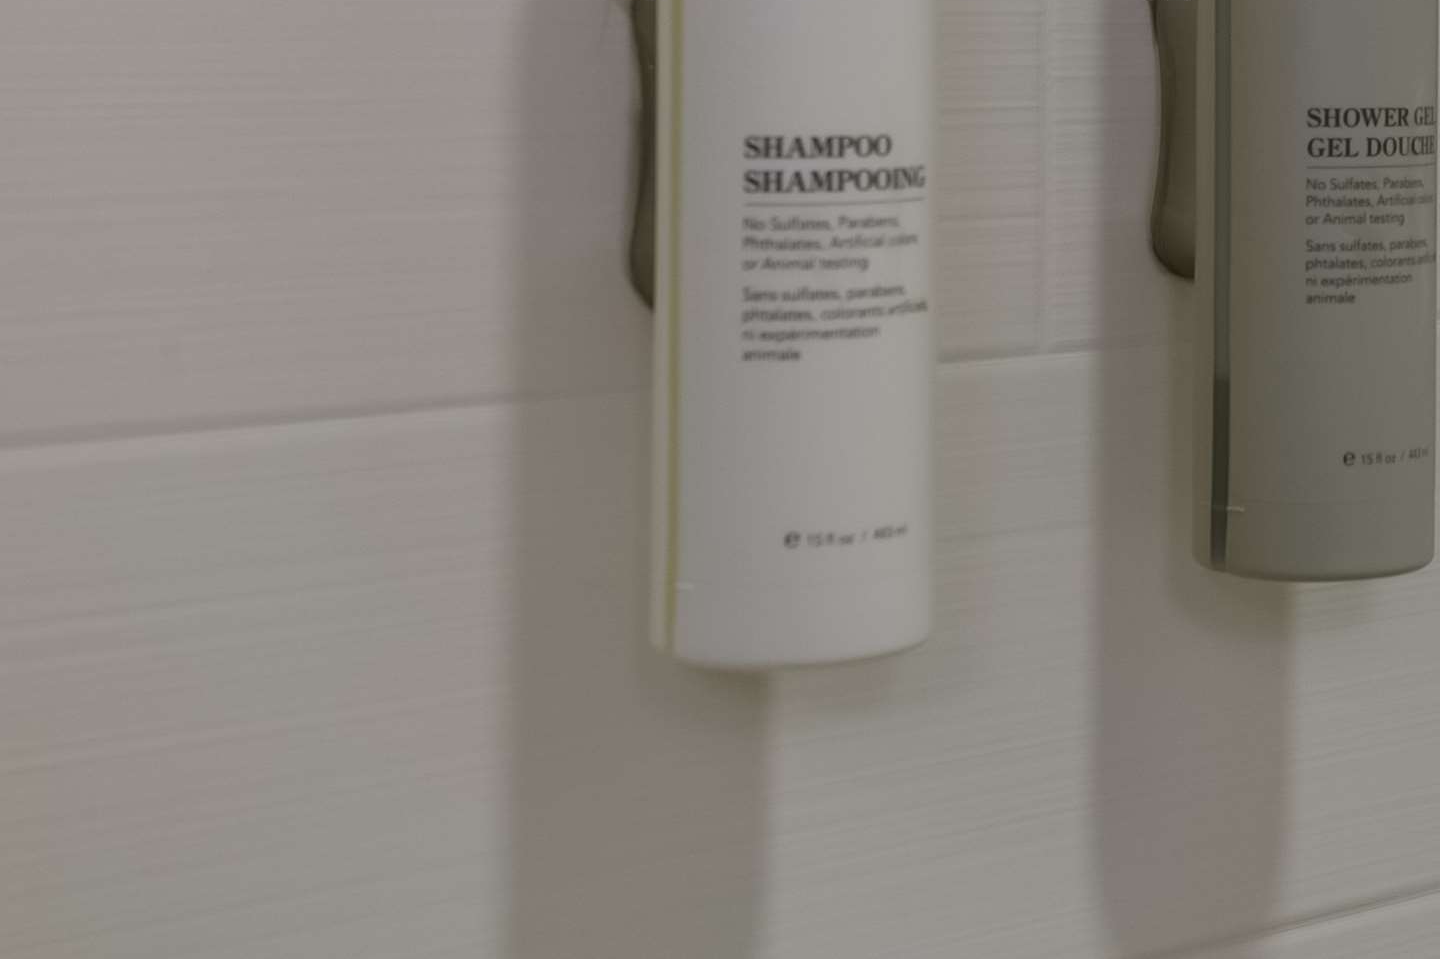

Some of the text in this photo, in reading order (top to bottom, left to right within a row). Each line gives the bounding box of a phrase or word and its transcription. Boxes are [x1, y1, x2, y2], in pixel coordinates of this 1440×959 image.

[1306, 107, 1409, 128] SHOWER
[743, 133, 893, 160] SHAMPOO
[1307, 135, 1435, 158] GEL DOUCHE
[743, 165, 925, 193] SHAMPOOING
[1306, 178, 1326, 190] No
[743, 217, 766, 231] No
[1306, 212, 1405, 226] or Animal testing
[1306, 239, 1336, 253] Sans
[1306, 291, 1355, 305] animale
